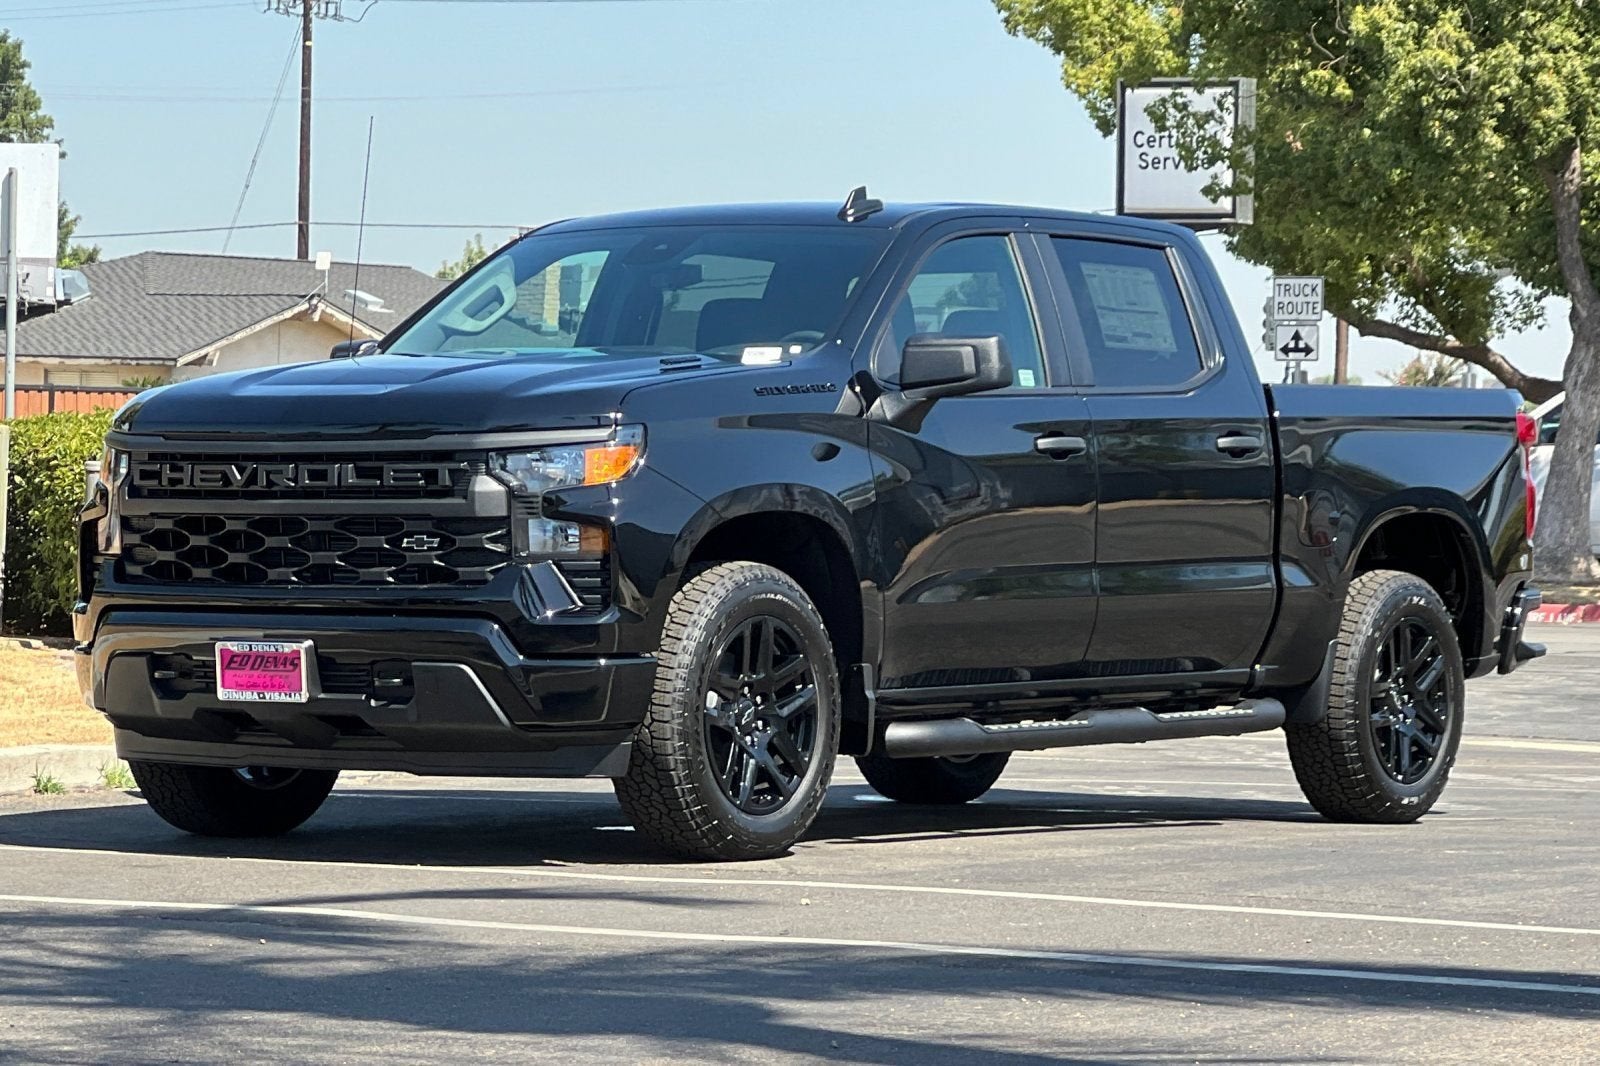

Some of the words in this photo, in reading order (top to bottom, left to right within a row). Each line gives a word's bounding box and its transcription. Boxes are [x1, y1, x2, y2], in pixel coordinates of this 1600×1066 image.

[1133, 130, 1218, 148] Certie
[1138, 152, 1212, 170] Serve
[1276, 283, 1319, 298] TRUCK
[1277, 301, 1320, 315] ROUTE
[753, 383, 838, 397] SILVERADO
[132, 462, 468, 489] CHEVROLET
[238, 644, 250, 652] ED
[252, 644, 283, 653] DENA'S
[225, 654, 252, 671] ED
[222, 691, 259, 700] DINUBA
[264, 692, 302, 701] VISALIA
